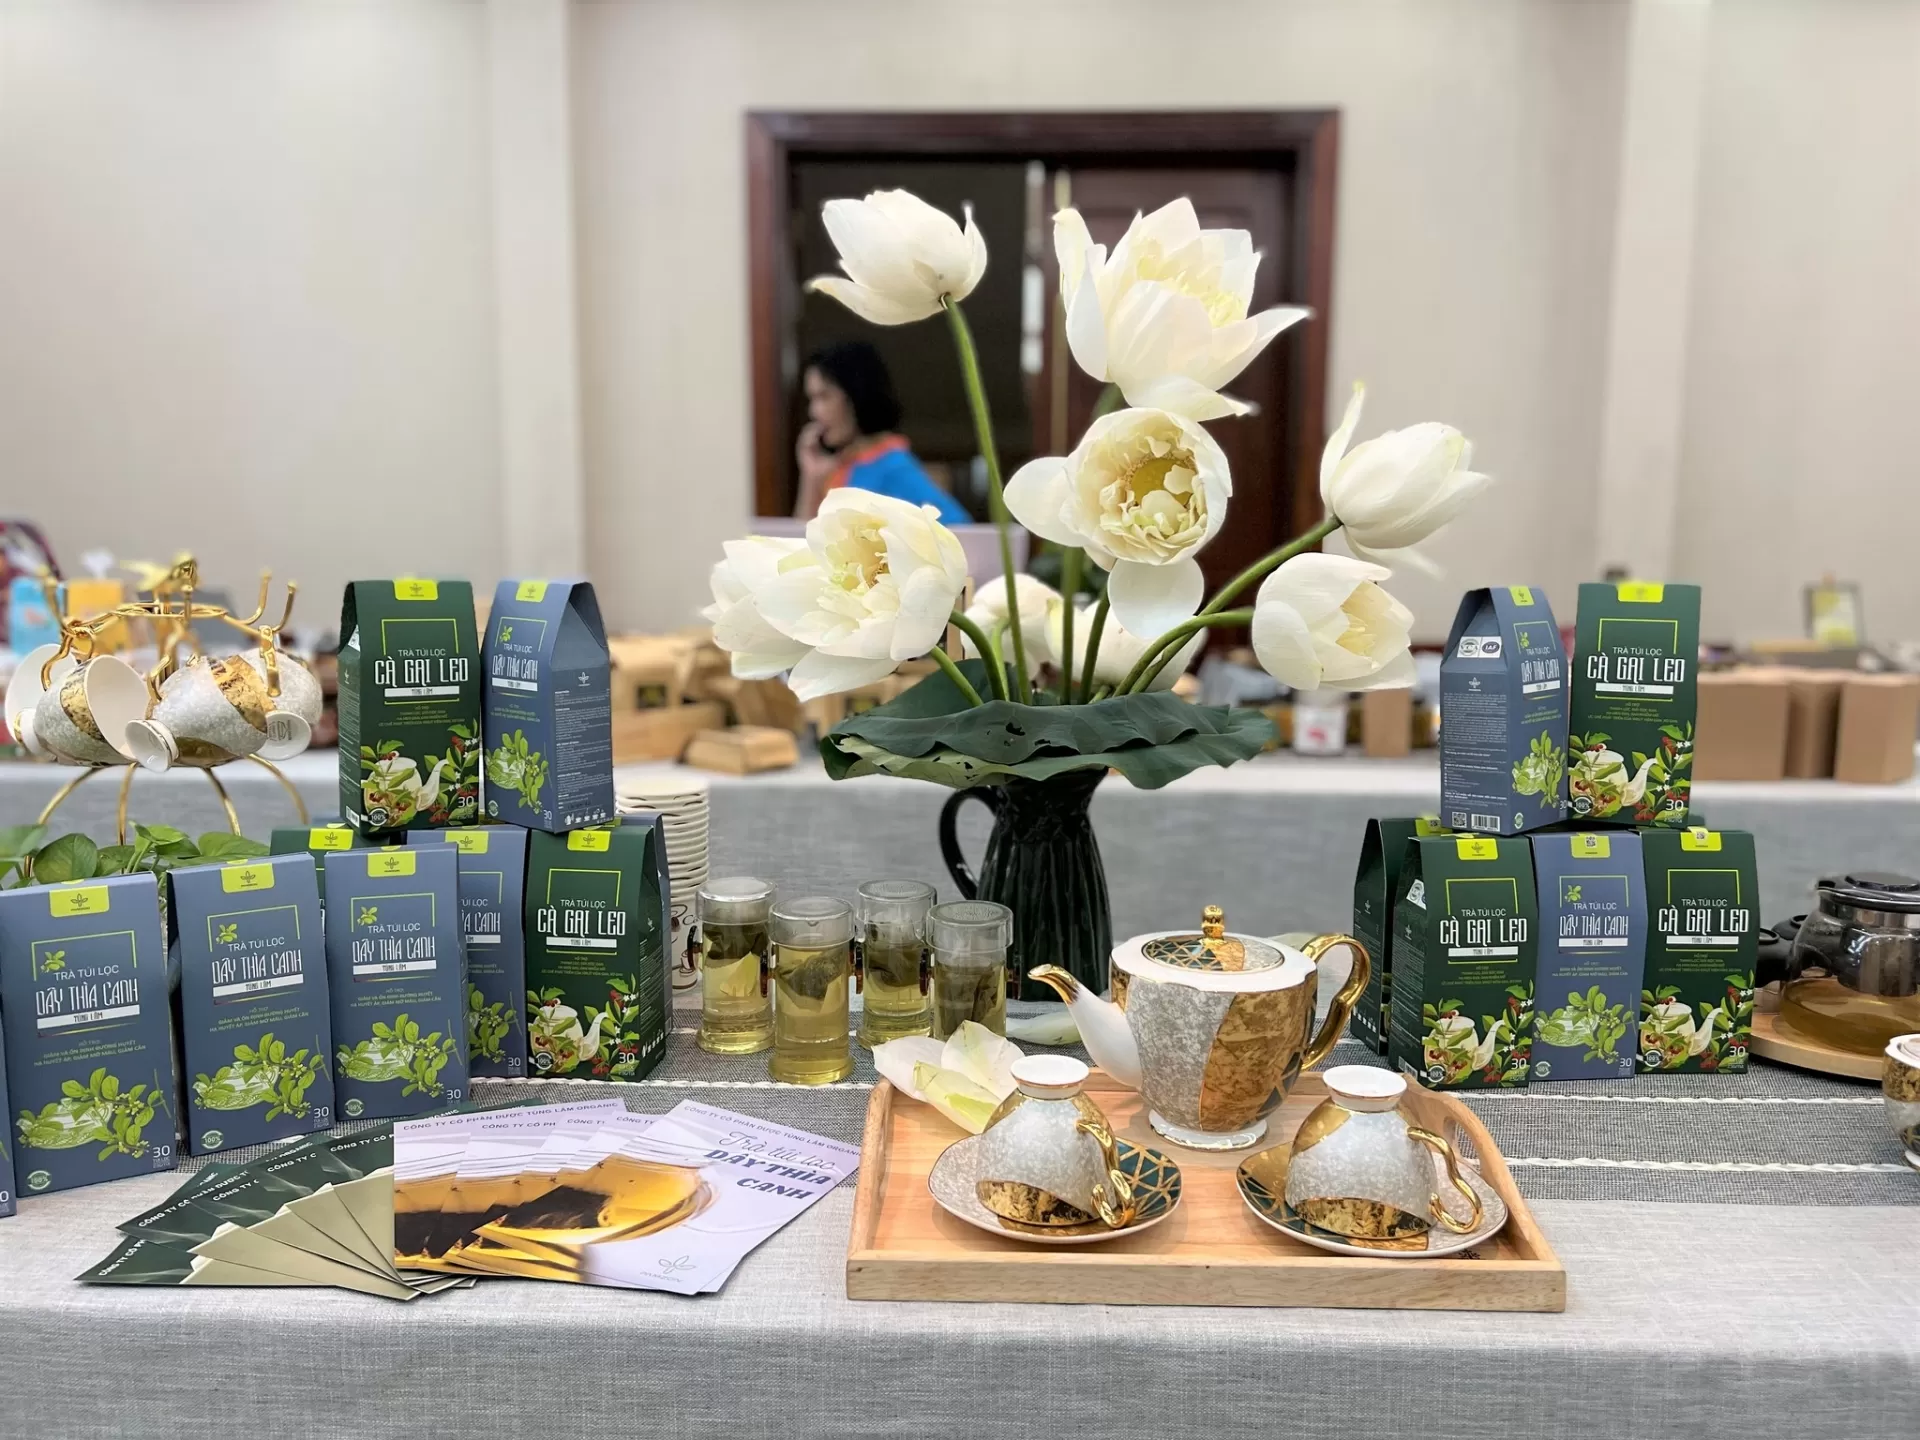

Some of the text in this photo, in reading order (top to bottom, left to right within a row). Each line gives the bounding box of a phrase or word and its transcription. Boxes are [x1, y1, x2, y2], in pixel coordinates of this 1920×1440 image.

[398, 648, 446, 658] TRÀ TÚI LỌC
[1612, 646, 1662, 656] TRÀ TÚI LỌC
[374, 656, 469, 687] CÀ GAI LEO
[1587, 652, 1685, 684] CÀ GAI LEO
[458, 796, 474, 808] 30
[1560, 800, 1567, 809] 30
[1665, 799, 1684, 811] 30
[543, 810, 552, 820] 30
[472, 898, 488, 907] LỌC
[560, 899, 606, 909] TRÀ TÚI LỌC
[1573, 900, 1617, 910] TRÀ TÚI LỌC
[1681, 897, 1728, 908] TRÀ TÚI LỌC
[1461, 907, 1507, 917] TRÀ TÚI LỌC
[474, 912, 500, 932] CANH
[537, 905, 626, 938] CÀ GAI LEO
[1560, 912, 1629, 936] DÂY THÌA CANH
[1658, 904, 1749, 936] CÀ GAI LEO
[368, 922, 421, 934] TRÀ TÚI LỌC
[1440, 915, 1528, 947] CÀ GAI LEO
[228, 936, 285, 953] TRÀ TÚI LỌC
[352, 935, 436, 963] DÂY THÌA CANH
[54, 964, 120, 981] TRÀ TÚI LỌC
[212, 949, 302, 985] DÂY THÌA CANH
[35, 978, 138, 1016] DÂY THÌA CANH
[619, 1052, 635, 1064] 30
[1729, 1046, 1746, 1058] 30
[508, 1057, 521, 1067] 30
[1511, 1058, 1527, 1069] 30
[1620, 1057, 1632, 1067] 30
[447, 1088, 461, 1100] 30
[313, 1106, 329, 1119] 30
[403, 1122, 432, 1131] CÔNG
[527, 1108, 552, 1116] TÙNG
[576, 1102, 619, 1111] ORGANIC
[567, 1117, 593, 1125] CÔNG
[616, 1115, 641, 1124] CÔNG
[684, 1105, 706, 1115] CÔNG
[783, 1132, 805, 1142] TÙNG
[806, 1138, 825, 1147] LÂM
[152, 1145, 171, 1158] 30
[330, 1142, 357, 1152] CÔNG
[719, 1131, 767, 1153] Trà
[768, 1146, 802, 1161] túi
[267, 1160, 295, 1173] CÔNG
[296, 1155, 308, 1163] TY
[703, 1149, 831, 1185] DÂY THÌA
[213, 1182, 252, 1201] CÔNG TY
[737, 1178, 814, 1199] CANH
[138, 1212, 165, 1227] CÔNG
[165, 1205, 177, 1215] TY
[98, 1262, 120, 1277] CÔNG
[117, 1254, 128, 1267] TY
